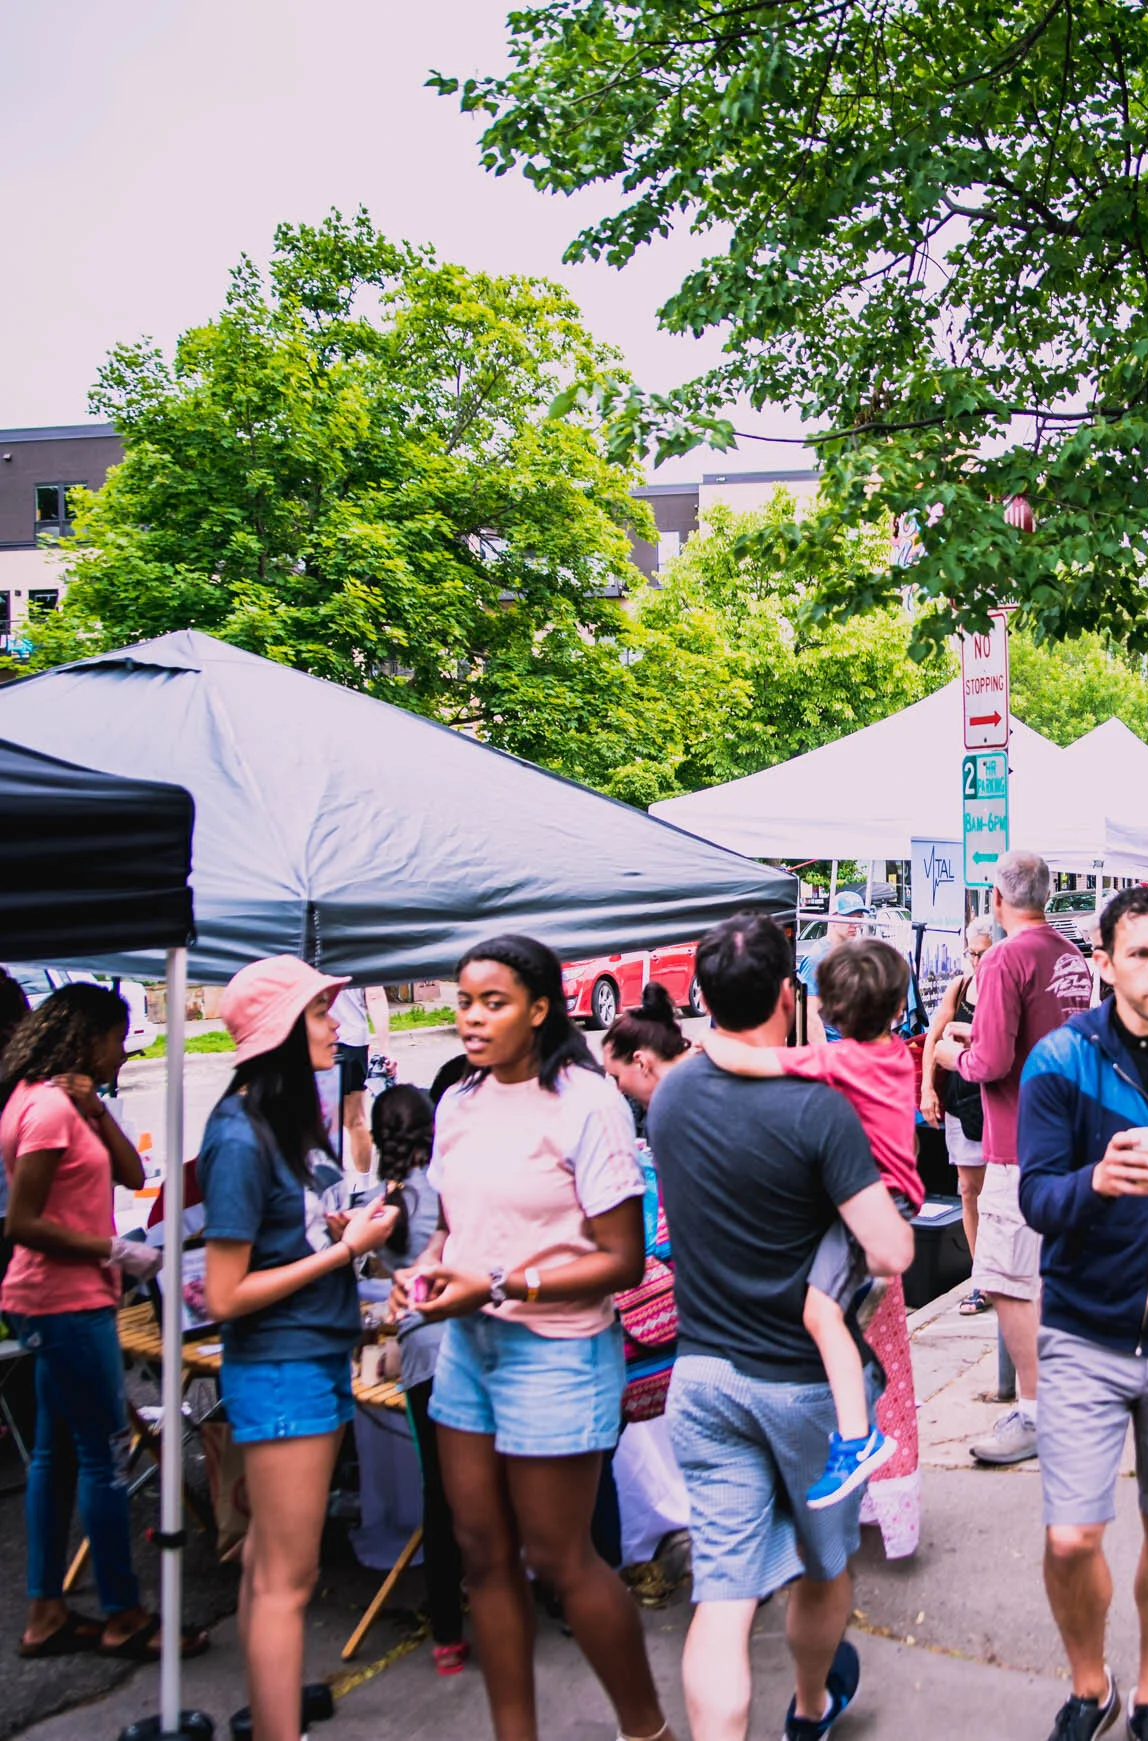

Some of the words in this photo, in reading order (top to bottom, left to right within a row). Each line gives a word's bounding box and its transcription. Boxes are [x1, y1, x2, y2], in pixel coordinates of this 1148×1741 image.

[974, 634, 991, 660] NO
[965, 674, 1004, 696] STOPPING
[964, 762, 976, 795] 2
[985, 760, 997, 776] HR
[977, 776, 1006, 794] PARKING
